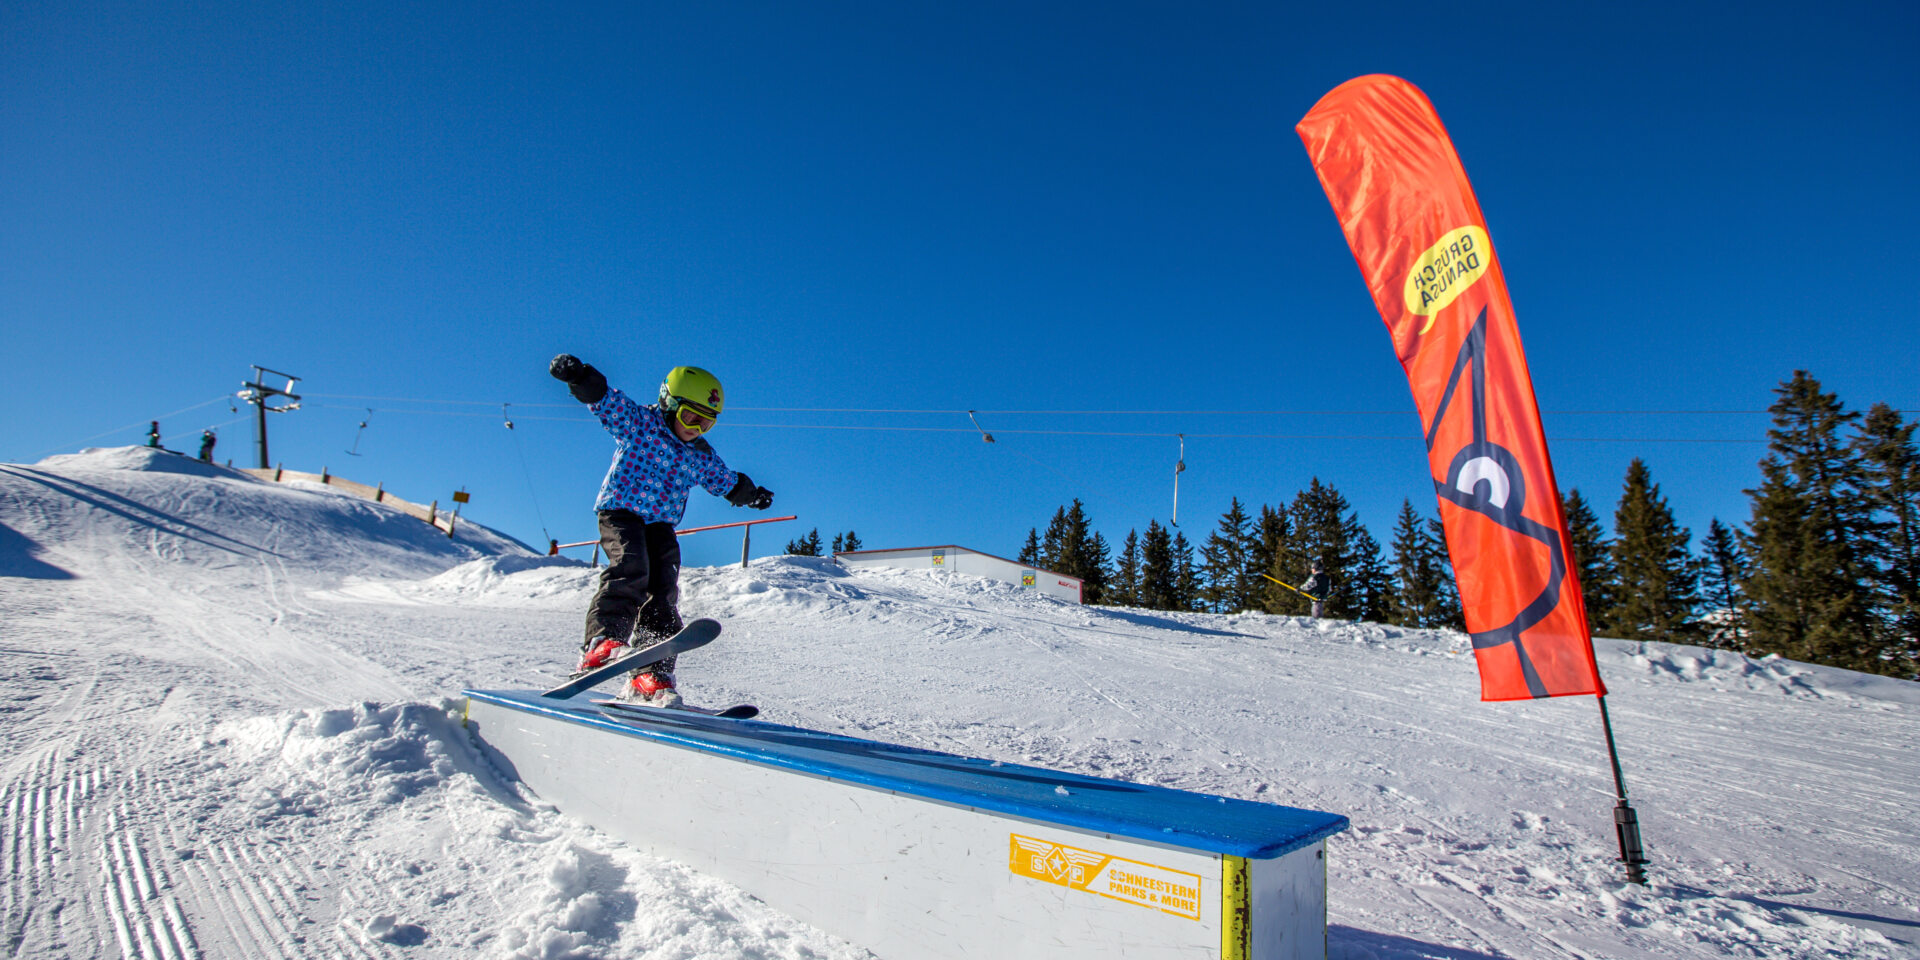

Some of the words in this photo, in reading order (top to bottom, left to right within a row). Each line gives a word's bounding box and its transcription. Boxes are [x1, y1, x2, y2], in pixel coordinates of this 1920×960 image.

[1109, 868, 1196, 899] SCHNEESTERN
[1109, 882, 1147, 900] PARKS
[1149, 893, 1158, 902] &
[1161, 895, 1196, 912] MORE
